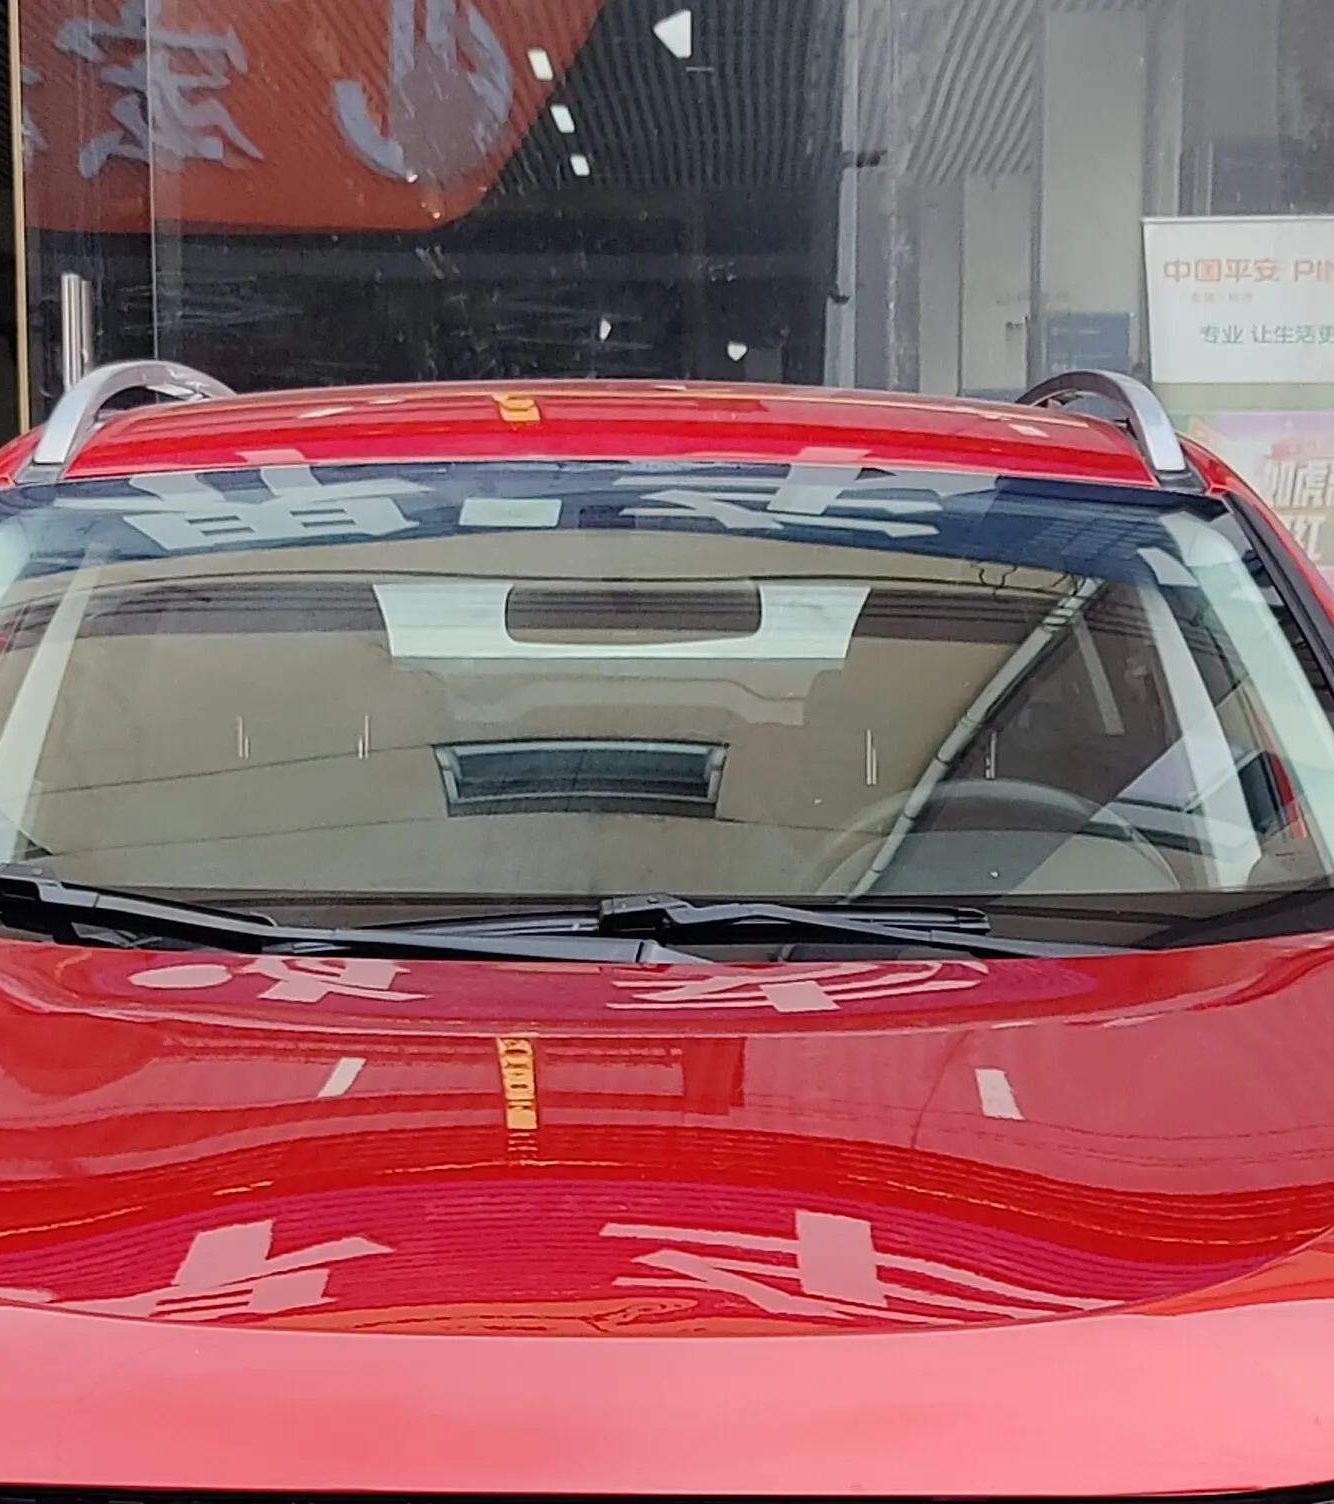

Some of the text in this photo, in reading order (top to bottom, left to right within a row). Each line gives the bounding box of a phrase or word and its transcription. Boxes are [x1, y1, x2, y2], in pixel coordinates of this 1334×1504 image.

[1163, 258, 1281, 283] 中国平安
[1200, 324, 1245, 345] 专业
